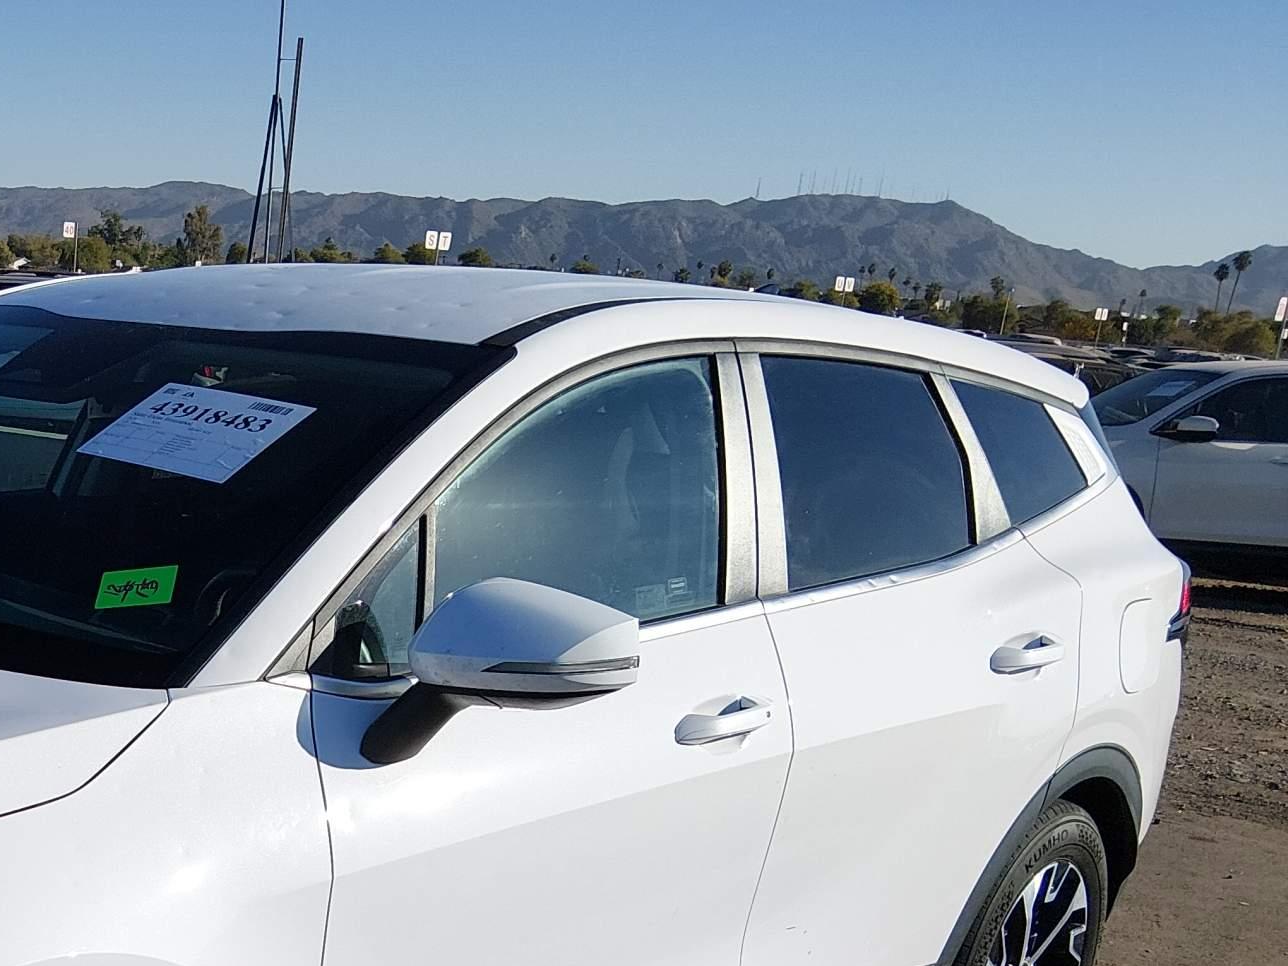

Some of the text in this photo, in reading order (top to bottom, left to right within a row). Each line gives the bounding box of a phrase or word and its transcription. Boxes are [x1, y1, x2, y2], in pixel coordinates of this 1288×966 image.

[428, 234, 435, 246] S
[149, 400, 273, 433] 43918483
[1024, 829, 1069, 874] KUMHO
